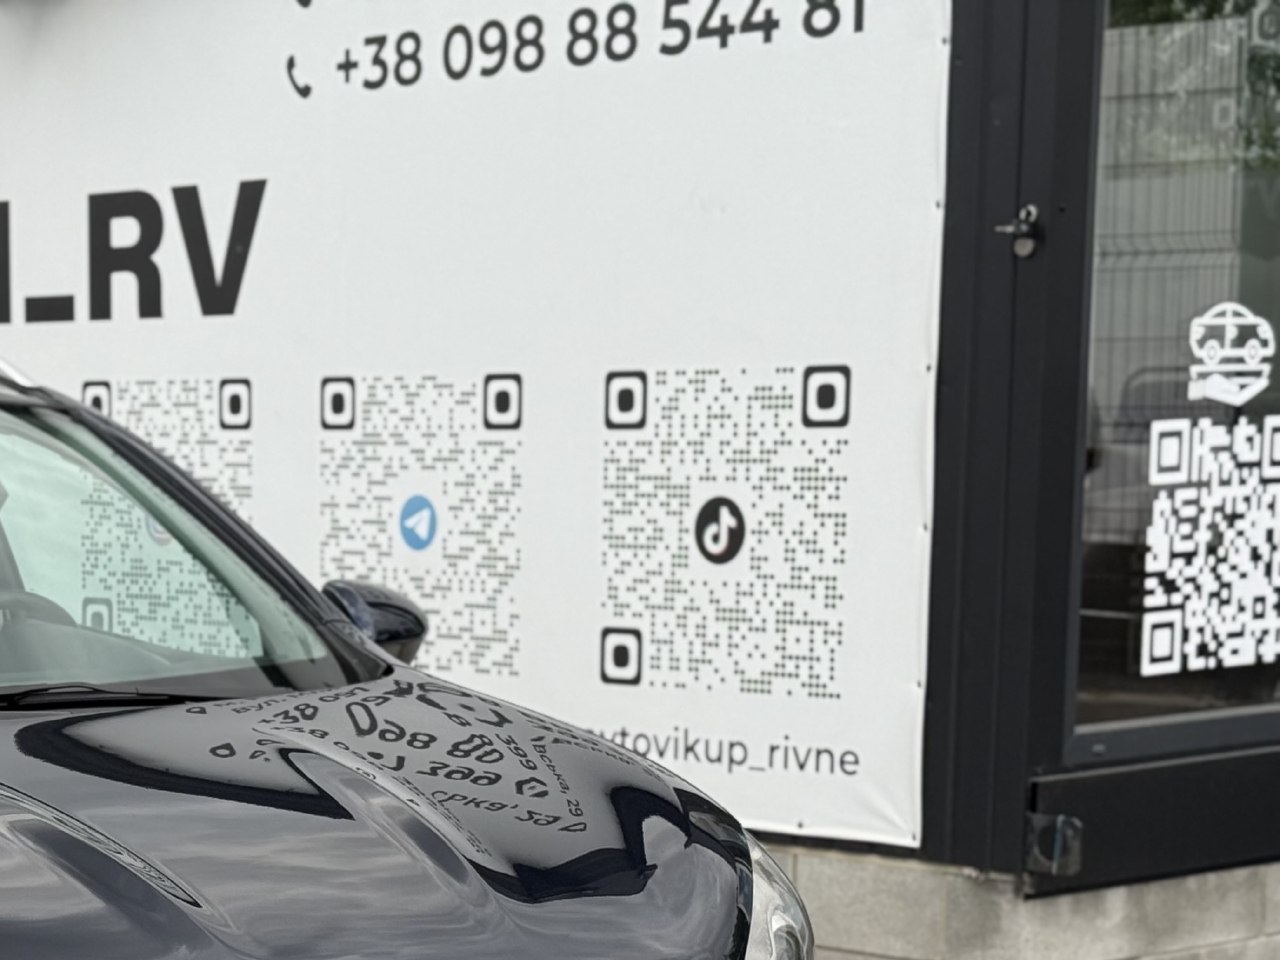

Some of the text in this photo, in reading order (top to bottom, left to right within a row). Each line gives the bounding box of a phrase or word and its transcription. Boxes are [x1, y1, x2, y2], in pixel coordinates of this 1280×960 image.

[337, 31, 422, 89] +38
[442, 14, 545, 80] 098
[566, 3, 638, 66] 88
[659, 0, 780, 56] 544
[585, 726, 860, 776] vtovikup_rivne
